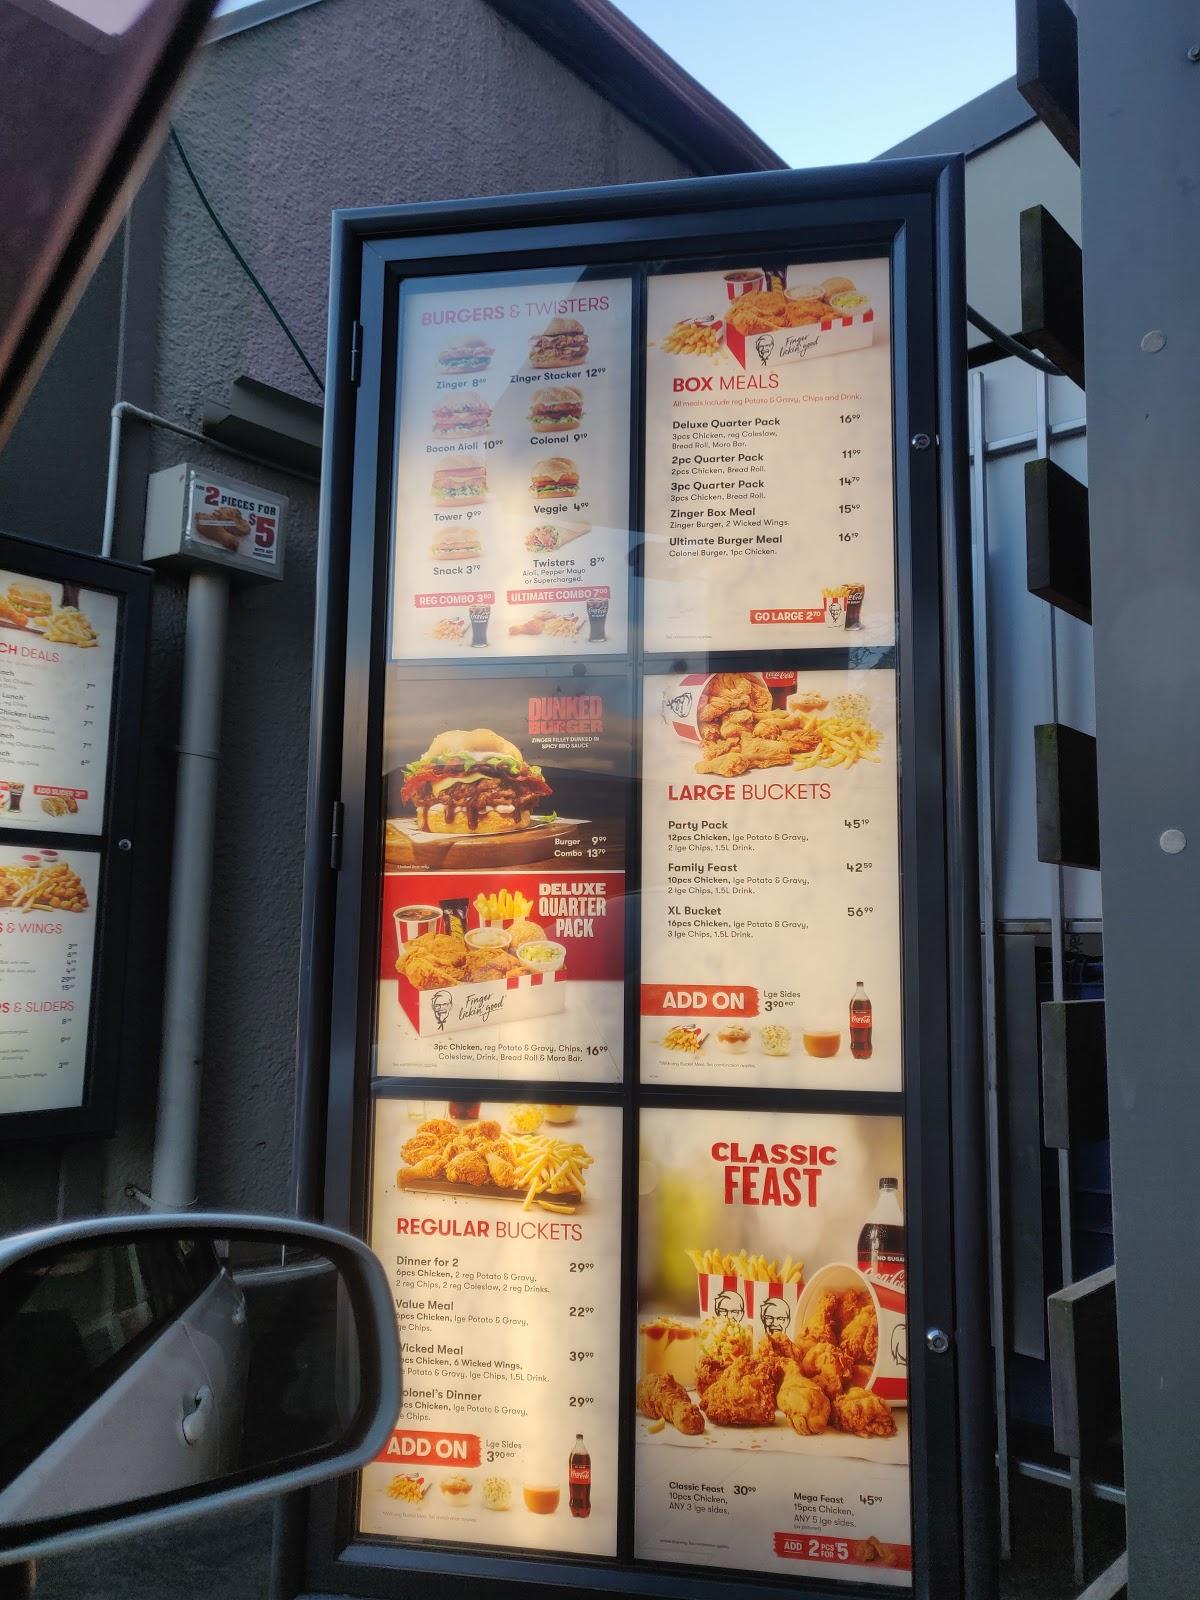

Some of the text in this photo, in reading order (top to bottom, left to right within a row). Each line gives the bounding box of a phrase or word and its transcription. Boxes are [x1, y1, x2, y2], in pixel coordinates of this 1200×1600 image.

[421, 296, 609, 326] BURGERS & TWISTERS
[510, 374, 541, 384] Zinger
[544, 371, 581, 380] Stacker
[673, 374, 779, 392] BOX MEALS
[436, 381, 467, 390] Zinger
[673, 420, 708, 429] Deluxe
[711, 419, 752, 428] Quarter
[755, 418, 780, 426] Pack
[530, 435, 569, 445] Colonel
[673, 432, 690, 440] 3pcs
[692, 431, 725, 440] Chicken,
[426, 443, 478, 453] Bacon Aioli
[672, 453, 764, 465] 2pc Quarter Pack
[691, 467, 725, 475] Chicken,
[671, 479, 764, 491] 3pc Quarter Pack
[205, 485, 220, 506] 2
[221, 496, 254, 510] PIECES
[258, 505, 276, 516] FOR
[534, 504, 568, 514] Veggie
[670, 507, 755, 518] Zinger Box Meal
[434, 513, 462, 521] Tower
[670, 521, 694, 529] Zinger
[696, 520, 724, 529] Burger,
[670, 535, 782, 546] Ultimate Burger Meal
[533, 559, 575, 568] Twisters
[433, 566, 463, 575] Snack
[541, 568, 565, 577] Pepper
[420, 595, 474, 605] REG COMBO
[511, 589, 591, 602] ULTIMATE COMBO
[755, 612, 803, 621] GO LARGE
[22, 647, 59, 662] DEALS
[528, 696, 602, 720] DUNKED
[668, 783, 831, 800] LARGE BUCKETS
[668, 821, 728, 831] Party Pack
[555, 837, 580, 846] Burger
[668, 834, 691, 842] 12pcs
[694, 834, 730, 842] Chicken,
[668, 863, 704, 874] Family
[707, 863, 738, 872] Feast
[668, 877, 692, 885] 10pcs
[694, 876, 731, 885] Chicken,
[539, 883, 606, 895] DELUXE
[689, 887, 713, 895] Chips,
[539, 897, 606, 917] QUARTER
[668, 907, 681, 915] XL
[684, 906, 721, 916] Bucket
[19, 923, 63, 934] WINGS
[556, 918, 593, 937] PACK
[668, 920, 692, 928] 16pcs
[694, 920, 731, 928] Chicken,
[764, 990, 800, 999] Lge Sides
[663, 992, 744, 1009] ADD ON
[26, 1001, 74, 1012] SLIDERS
[559, 1045, 582, 1053] Chips,
[711, 1142, 838, 1166] CLASSIC
[724, 1166, 822, 1207] FEAST
[397, 1218, 582, 1241] REGULAR BUCKETS
[397, 1256, 459, 1267] Dinner for 2
[396, 1270, 501, 1280] 6pcs Chicken, Potato
[417, 1280, 549, 1293] Chips, Coleslaw, Drinks.
[396, 1300, 425, 1309] Value
[428, 1300, 453, 1310] Meal
[438, 1345, 463, 1355] Meal
[416, 1357, 522, 1370] Chicken, Wicked Wings,
[402, 1388, 481, 1400] olonel's Dinner
[387, 1437, 467, 1459] ADD ON
[486, 1439, 522, 1449] Lge Sides
[669, 1482, 699, 1491] Classic
[702, 1484, 724, 1494] Feast
[669, 1493, 728, 1504] 10pcs Chicken,
[794, 1493, 818, 1503] Mega
[820, 1495, 843, 1504] Feast
[794, 1504, 854, 1516] 15pcs Chicken,
[794, 1515, 810, 1523] ANY
[784, 1540, 834, 1557] ADD 2 PCS
